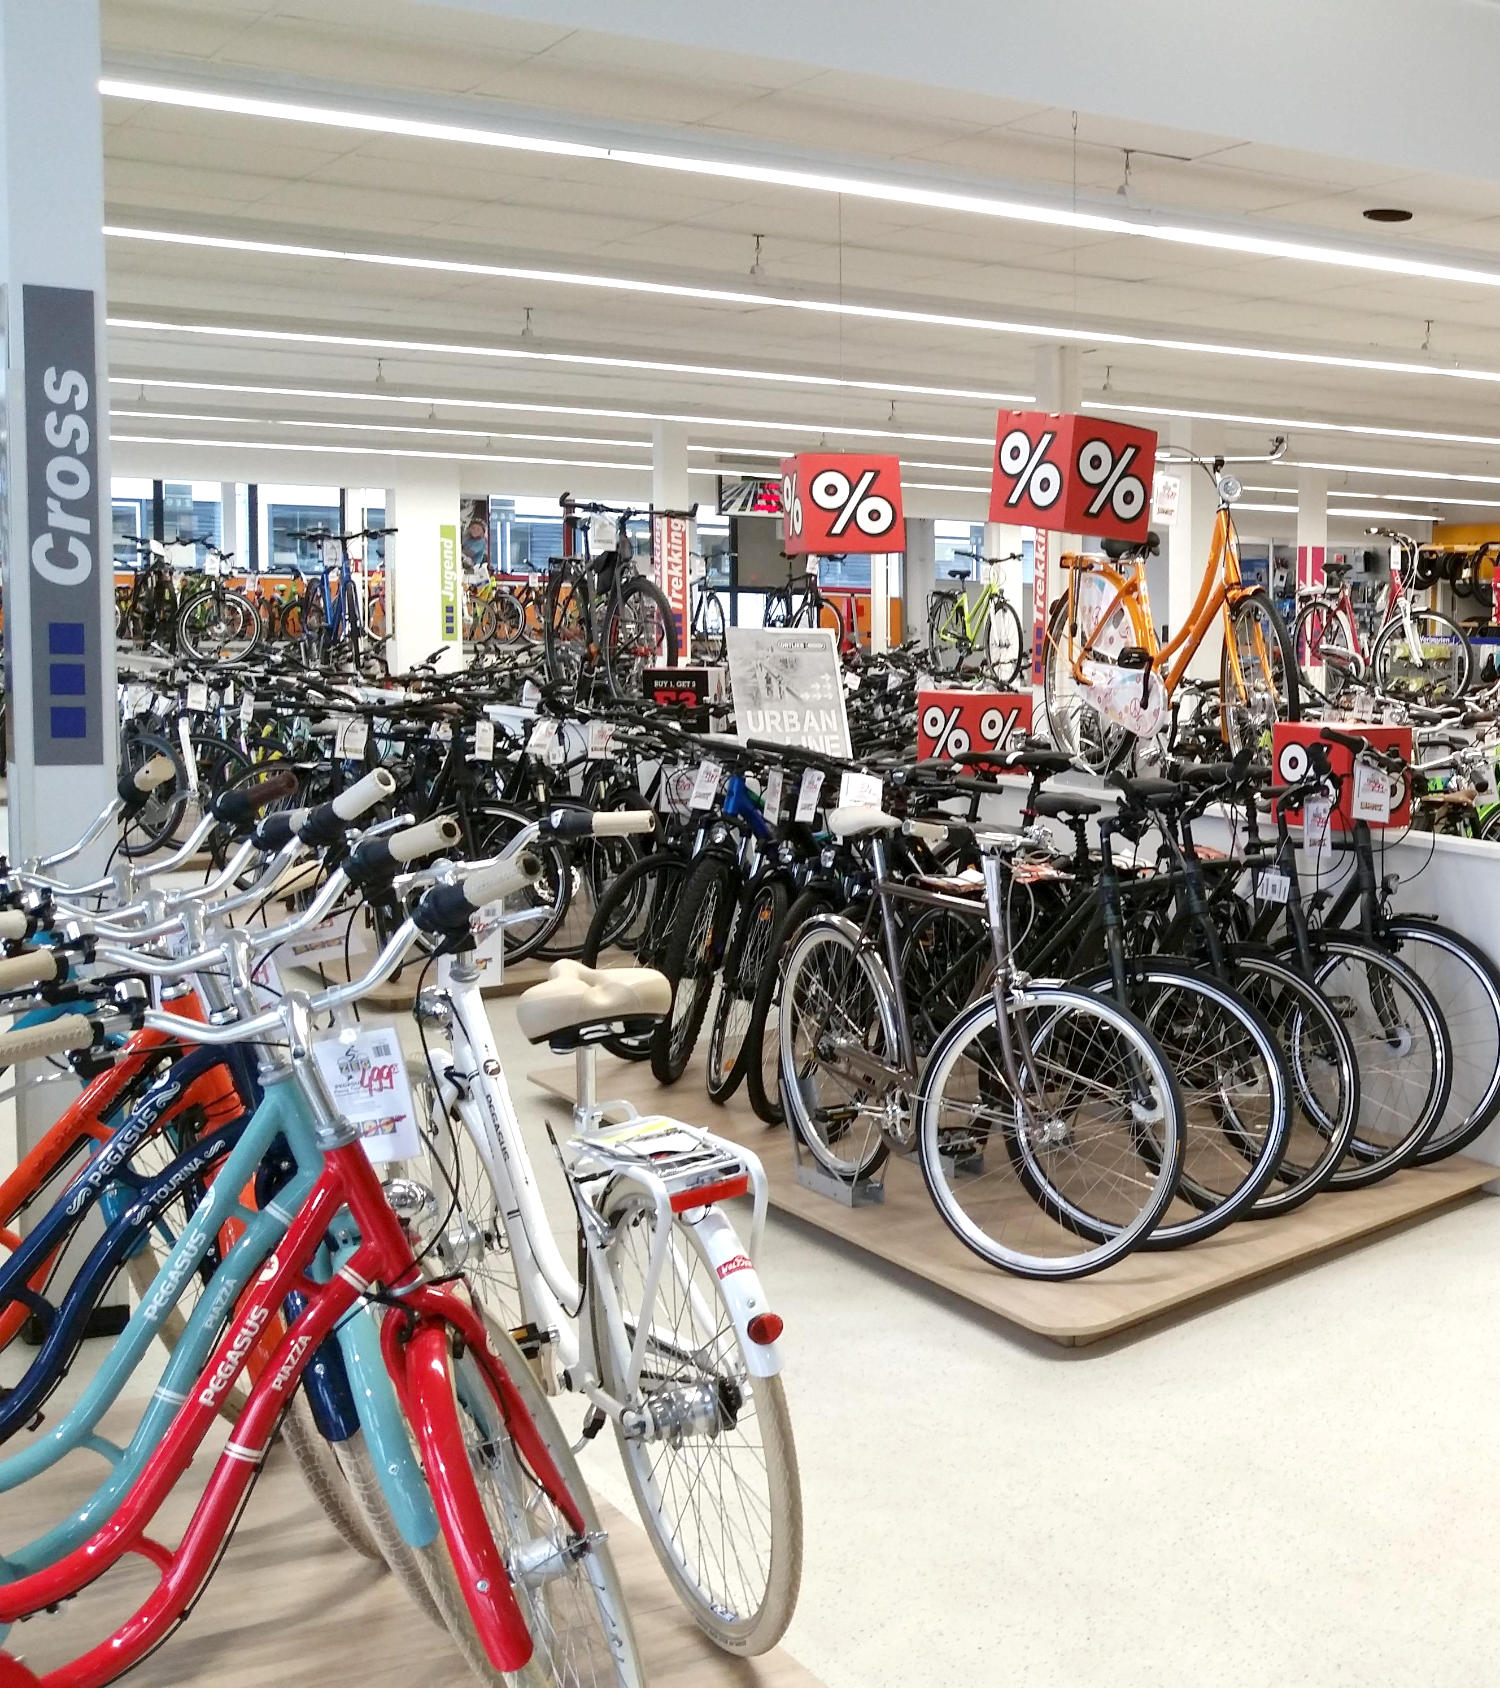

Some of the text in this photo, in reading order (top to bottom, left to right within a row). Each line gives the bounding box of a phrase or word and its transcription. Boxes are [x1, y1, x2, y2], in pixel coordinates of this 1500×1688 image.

[31, 365, 93, 586] Cross
[440, 537, 457, 602] Jugend
[667, 518, 687, 610] Trekking
[1033, 528, 1047, 624] Trekki
[654, 680, 668, 688] BUY
[676, 680, 690, 688] GET
[746, 709, 838, 733] URBAN
[88, 1108, 158, 1186] PEGASUS
[486, 1094, 510, 1161] PEGASUS
[150, 1157, 205, 1205] TOURINA
[143, 1228, 207, 1322] PEGASUS
[204, 1279, 238, 1330] PIAZZA
[199, 1305, 269, 1407] PEGASUS
[272, 1335, 312, 1392] PIAZZA
